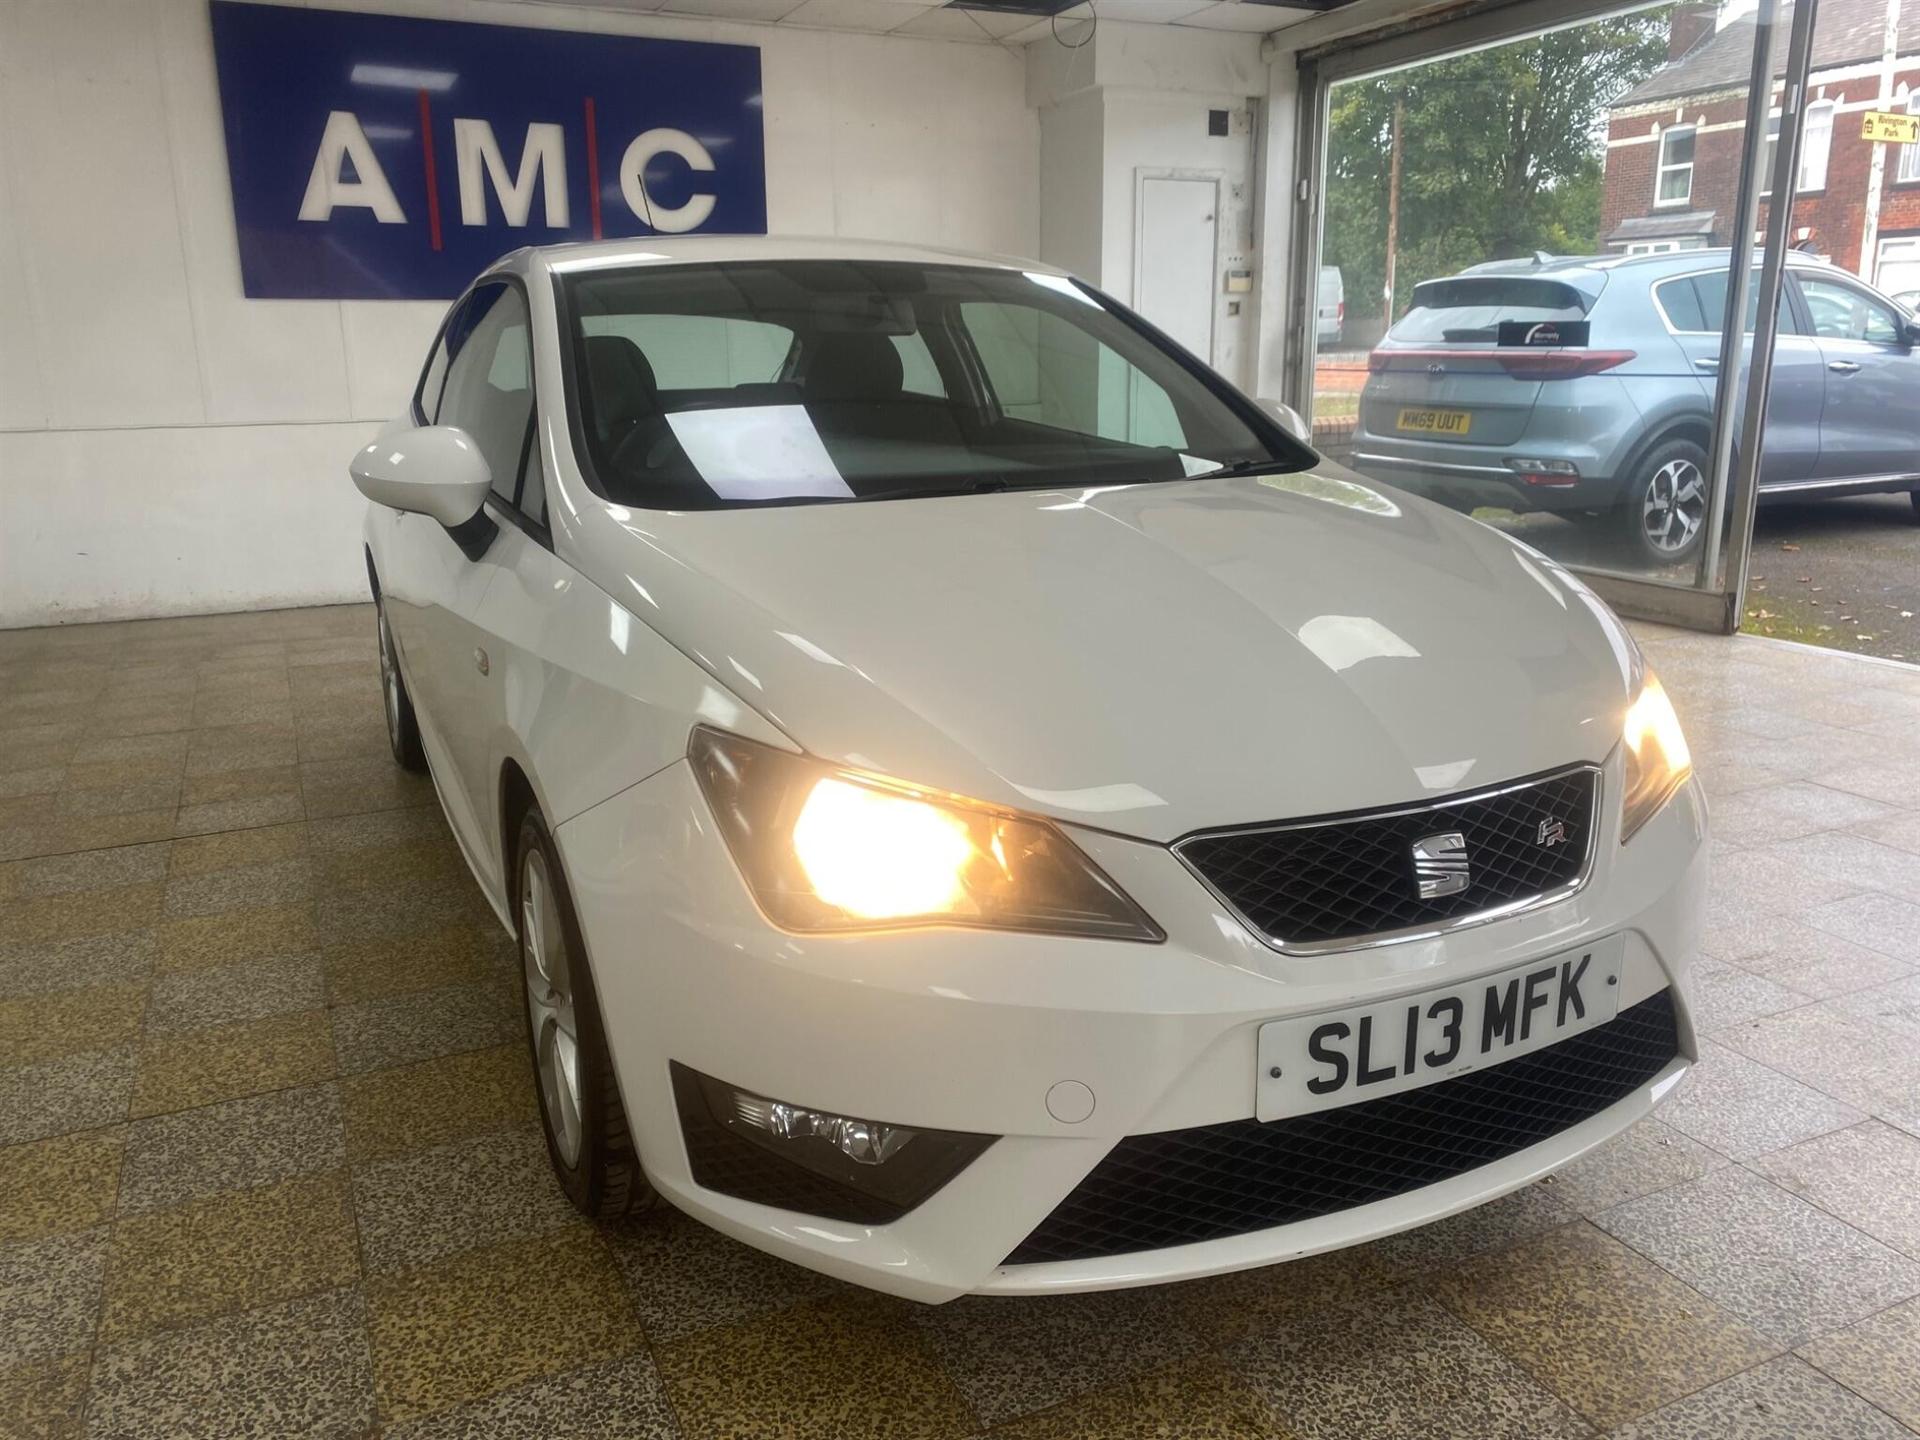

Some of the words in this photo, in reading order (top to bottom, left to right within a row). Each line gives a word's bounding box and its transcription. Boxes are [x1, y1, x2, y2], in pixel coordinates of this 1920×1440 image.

[1878, 115, 1907, 128] Rivington
[1884, 127, 1898, 137] Park
[1402, 411, 1436, 429] MM69
[1437, 412, 1465, 431] UUT
[1306, 996, 1464, 1095] SL13
[1480, 953, 1592, 1054] MFK
